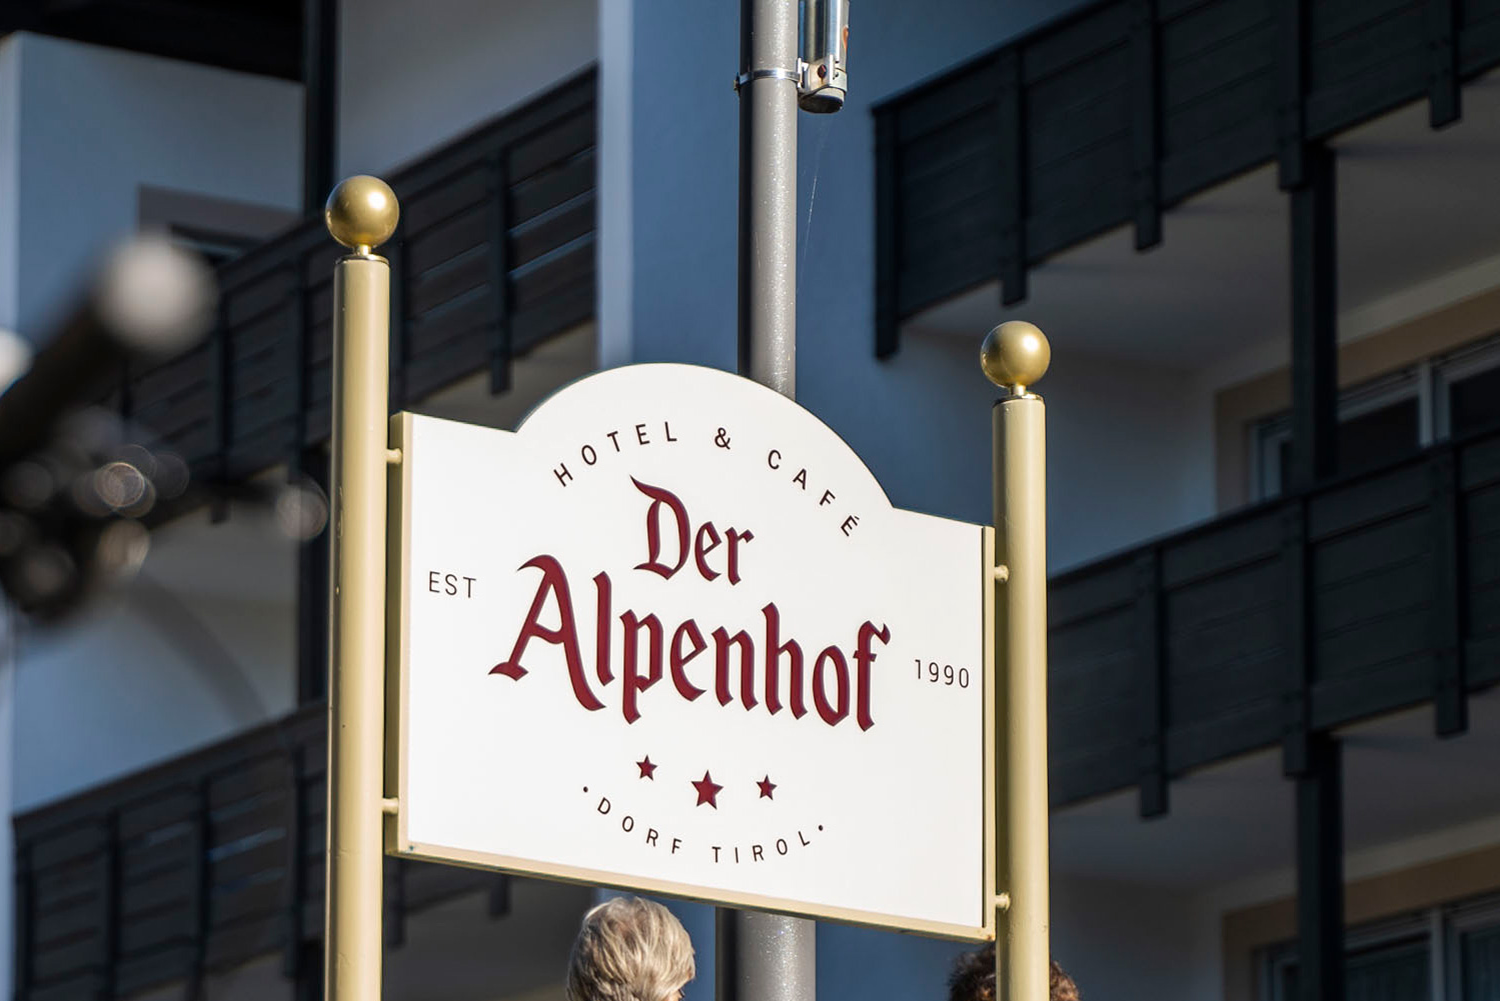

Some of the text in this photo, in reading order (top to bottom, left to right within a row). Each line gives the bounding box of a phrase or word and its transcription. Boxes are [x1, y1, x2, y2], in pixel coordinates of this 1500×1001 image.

[553, 421, 860, 537] HOTEL & CAFÉ
[629, 474, 755, 587] Der
[428, 570, 478, 599] EST
[487, 554, 892, 733] Alpenhof
[913, 658, 970, 689] 1990
[596, 796, 811, 864] DORF TIROL
